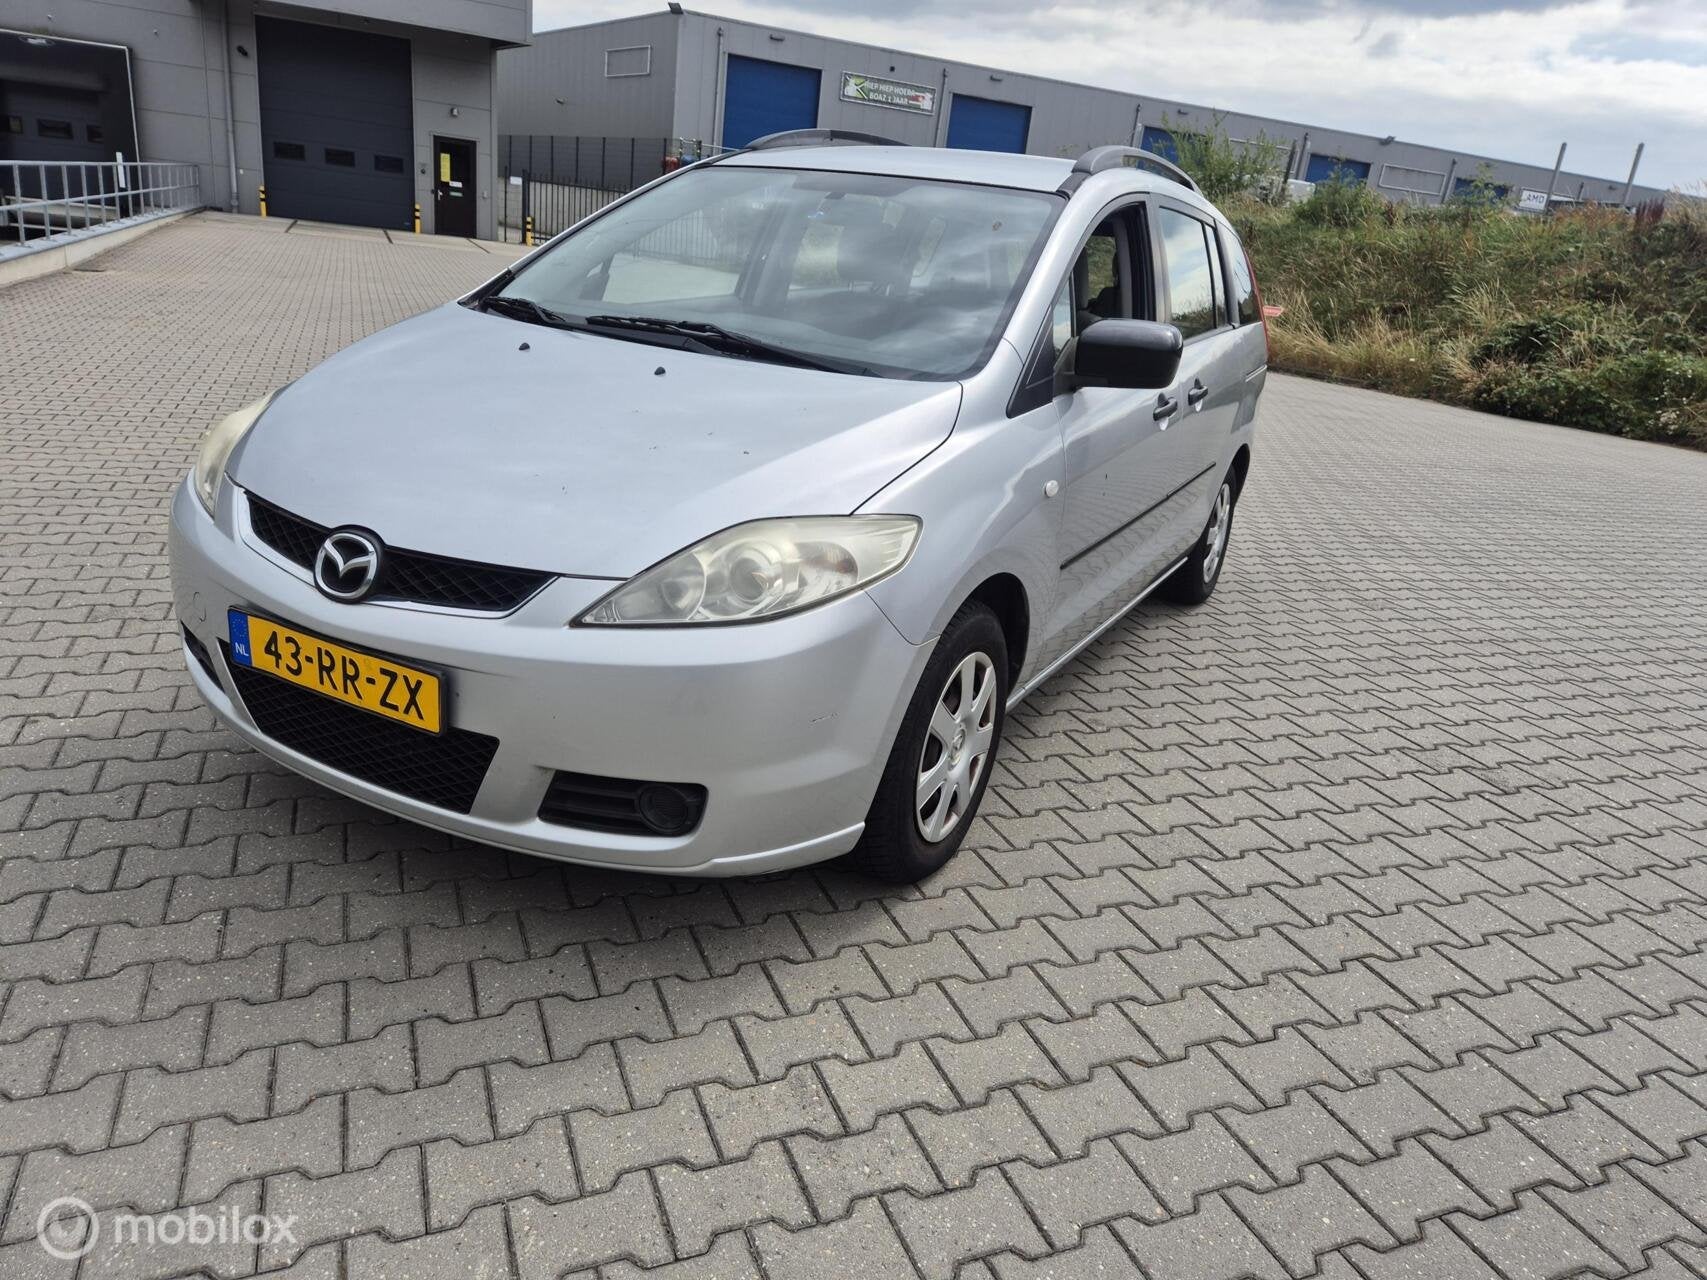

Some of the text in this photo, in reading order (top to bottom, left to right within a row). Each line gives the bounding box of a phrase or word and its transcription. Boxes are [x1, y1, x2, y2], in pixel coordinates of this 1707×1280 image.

[869, 92, 886, 101] BOAZ
[892, 96, 908, 105] JAAR
[235, 642, 249, 657] NL
[264, 630, 425, 721] 43-RR-ZX
